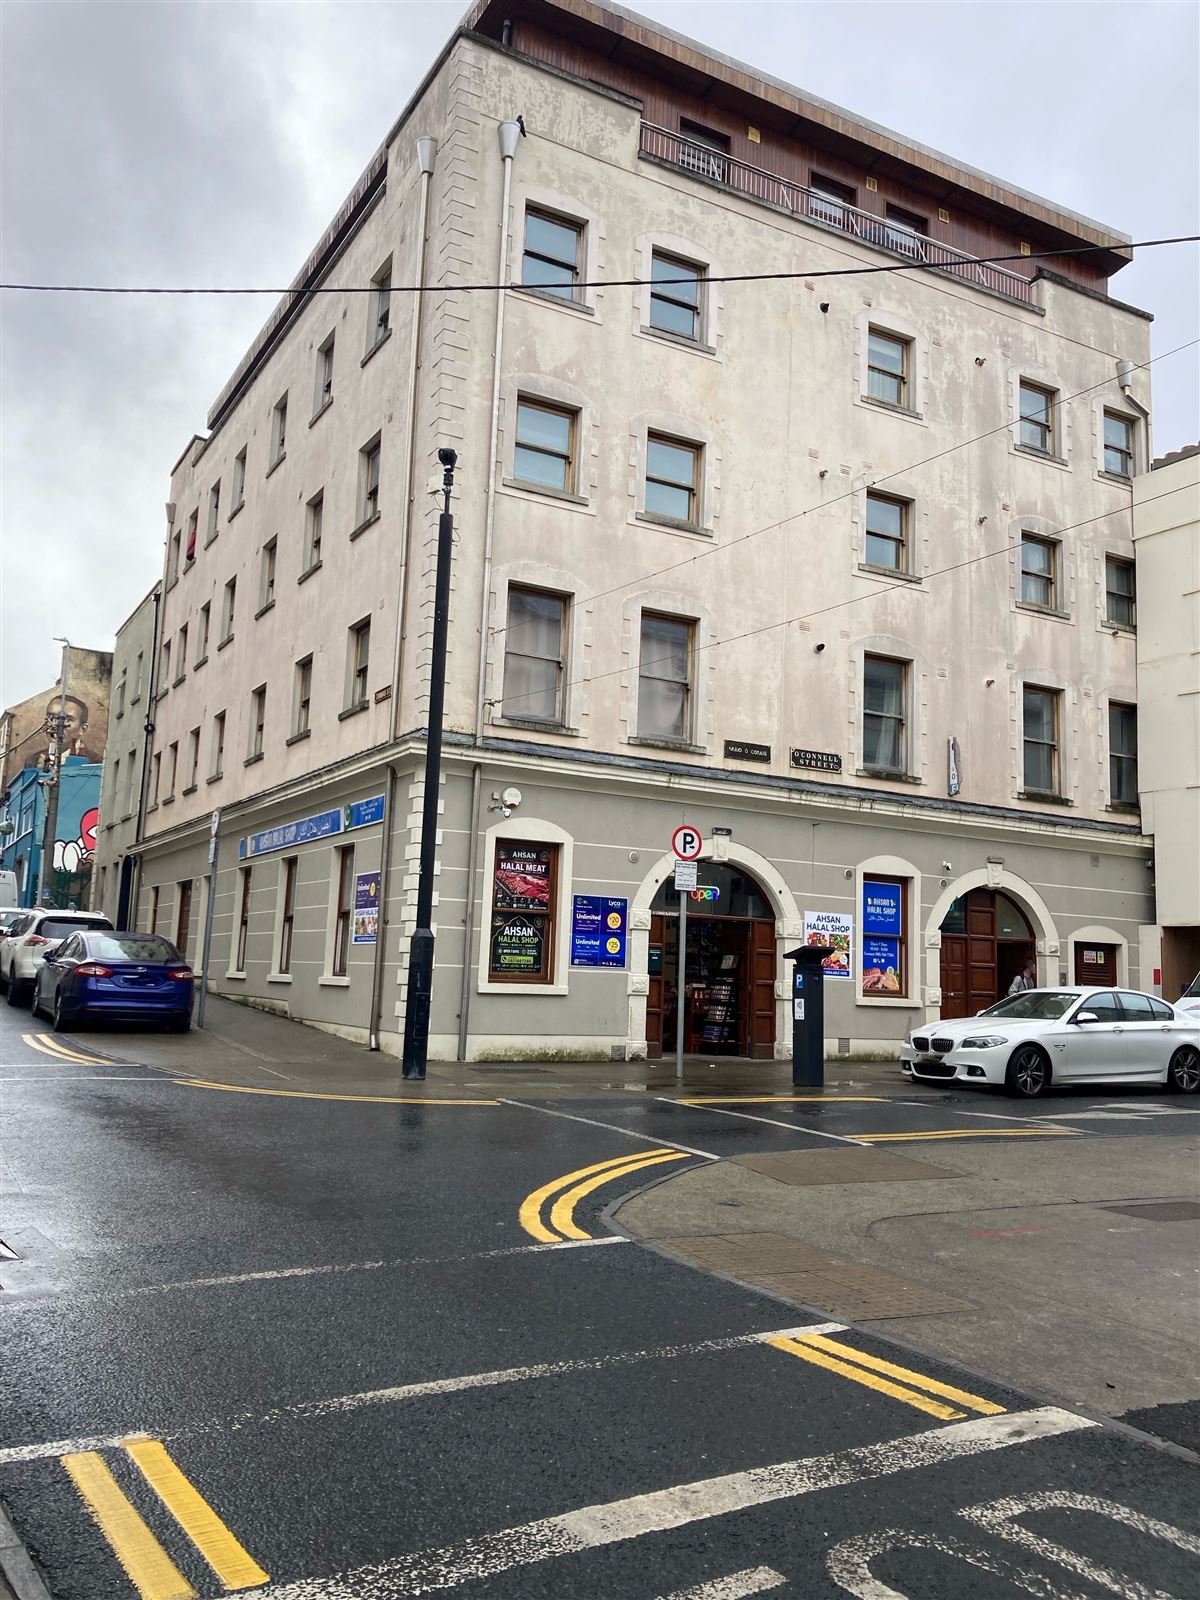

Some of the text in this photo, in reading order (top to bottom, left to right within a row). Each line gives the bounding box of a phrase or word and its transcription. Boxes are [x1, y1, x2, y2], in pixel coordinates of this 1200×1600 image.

[799, 759, 834, 769] STREET
[682, 832, 695, 853] P
[512, 851, 537, 859] AHSAN
[500, 862, 525, 871] HALAL
[525, 864, 546, 873] MEAT
[608, 899, 621, 907] Lyca
[576, 912, 602, 920] Unlimited
[866, 906, 897, 916] HALAL SHOP
[815, 914, 841, 924] AHSAN
[503, 926, 533, 937] AHSAN
[806, 923, 850, 933] HALAL SHOP
[498, 935, 539, 944] HALAL SHOP
[575, 938, 600, 946] Unlimited
[796, 974, 803, 986] P
